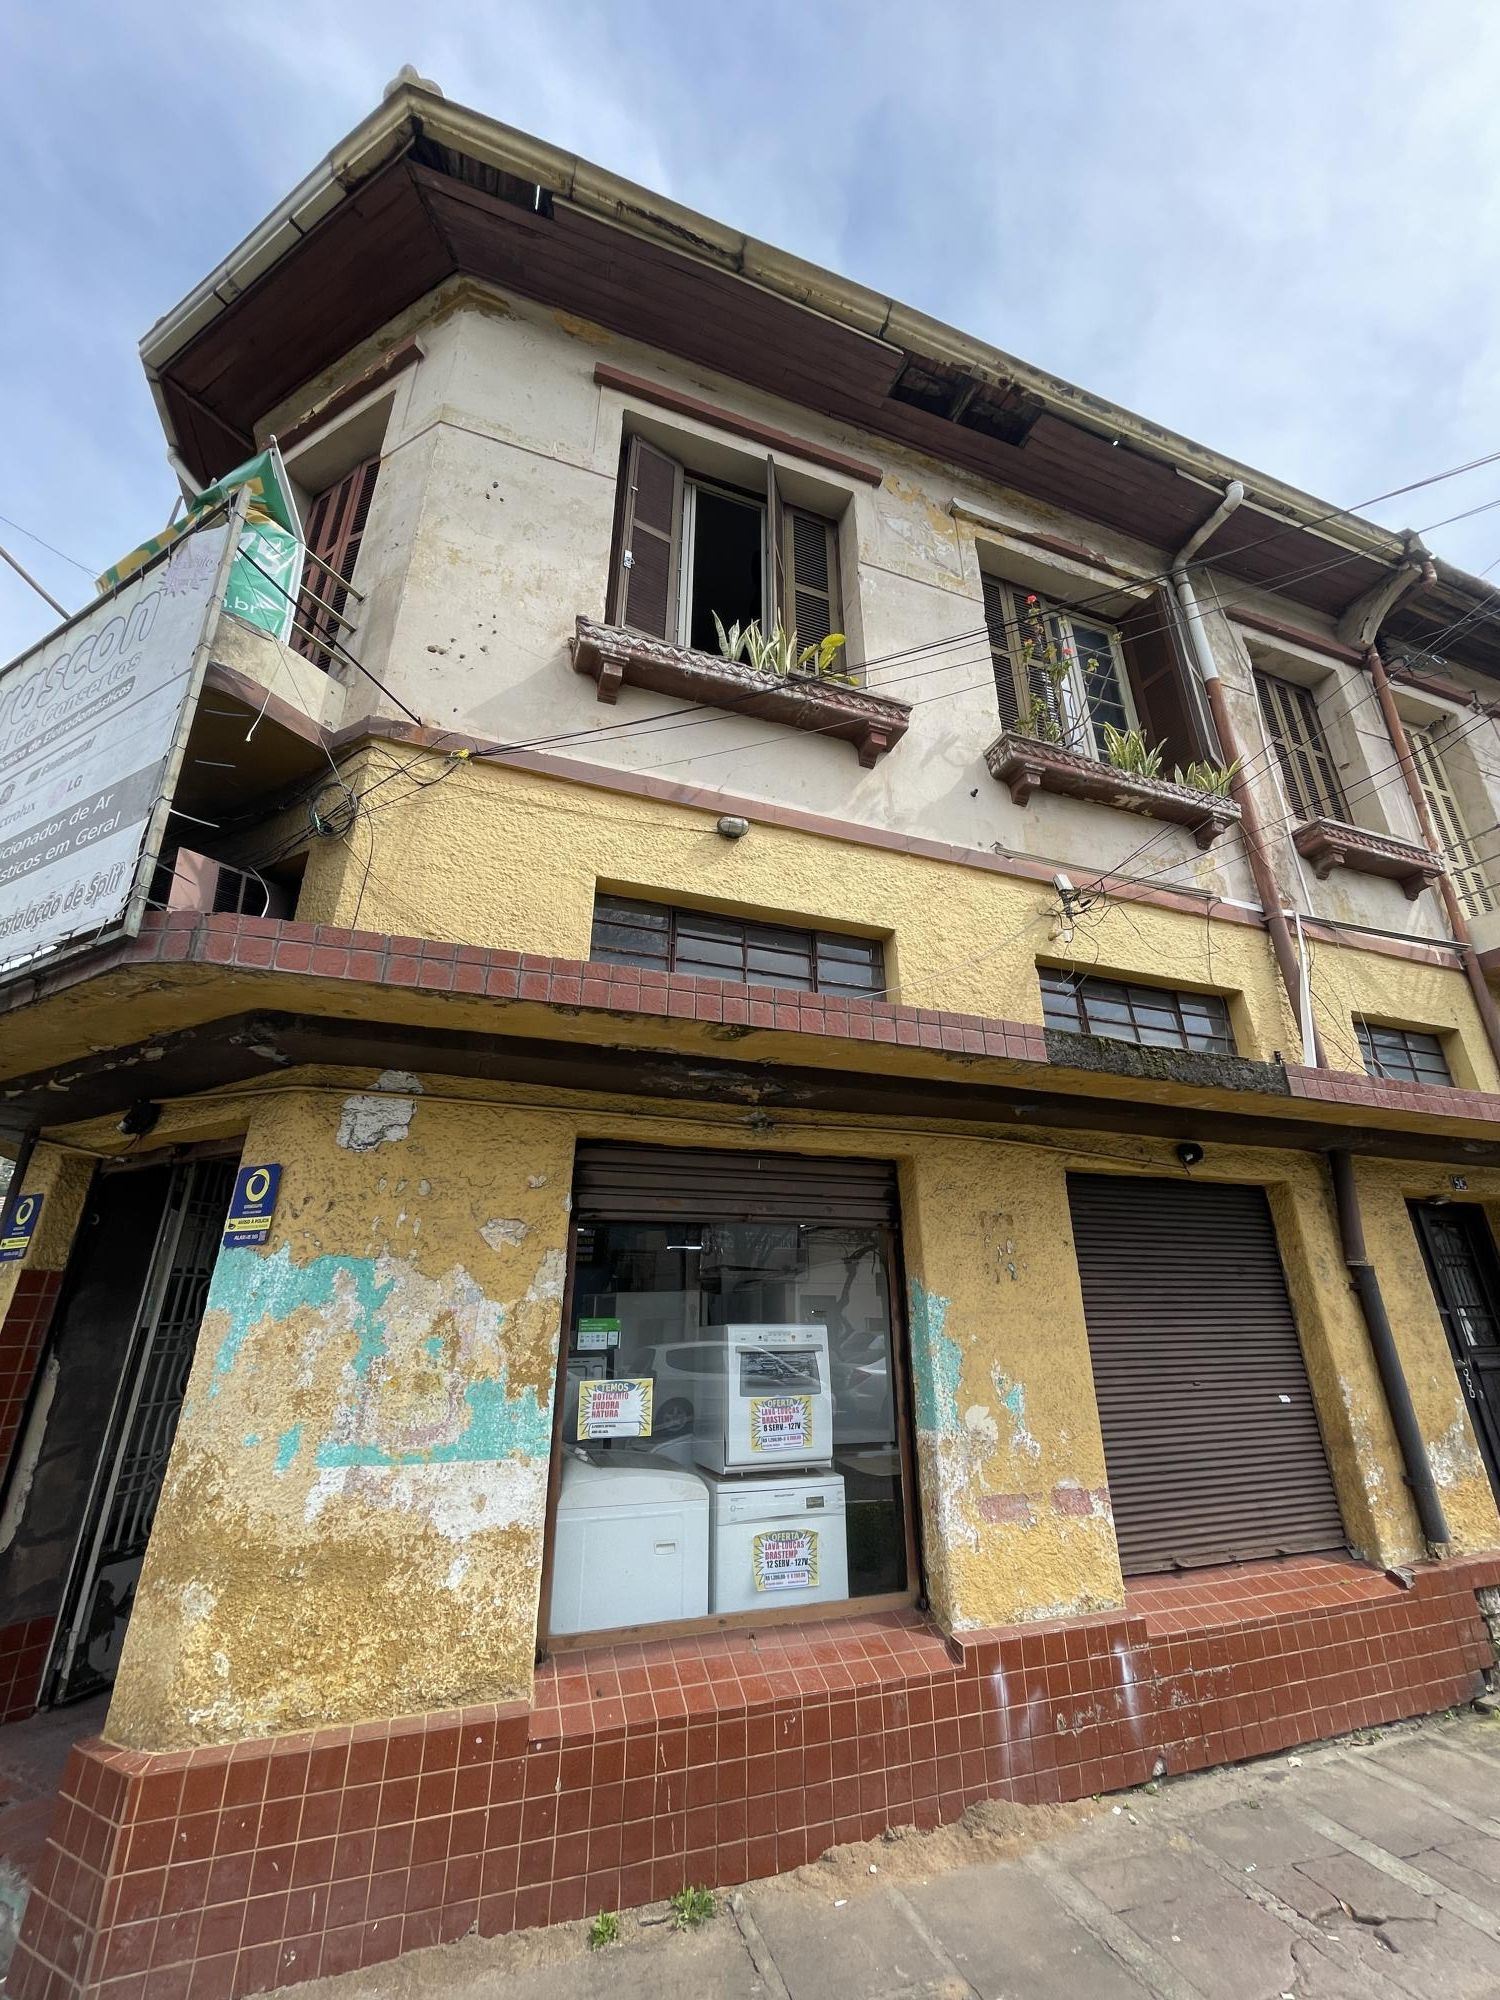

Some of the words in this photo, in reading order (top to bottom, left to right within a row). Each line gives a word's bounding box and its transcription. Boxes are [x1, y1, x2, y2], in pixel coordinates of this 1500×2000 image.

[69, 807, 90, 826] de
[93, 793, 114, 814] Ar
[46, 840, 70, 861] em
[75, 811, 121, 846] Geral
[62, 880, 85, 914] de
[84, 862, 126, 909] Split
[771, 1532, 799, 1541] OFERTA
[764, 1550, 798, 1560] BRASTEMP
